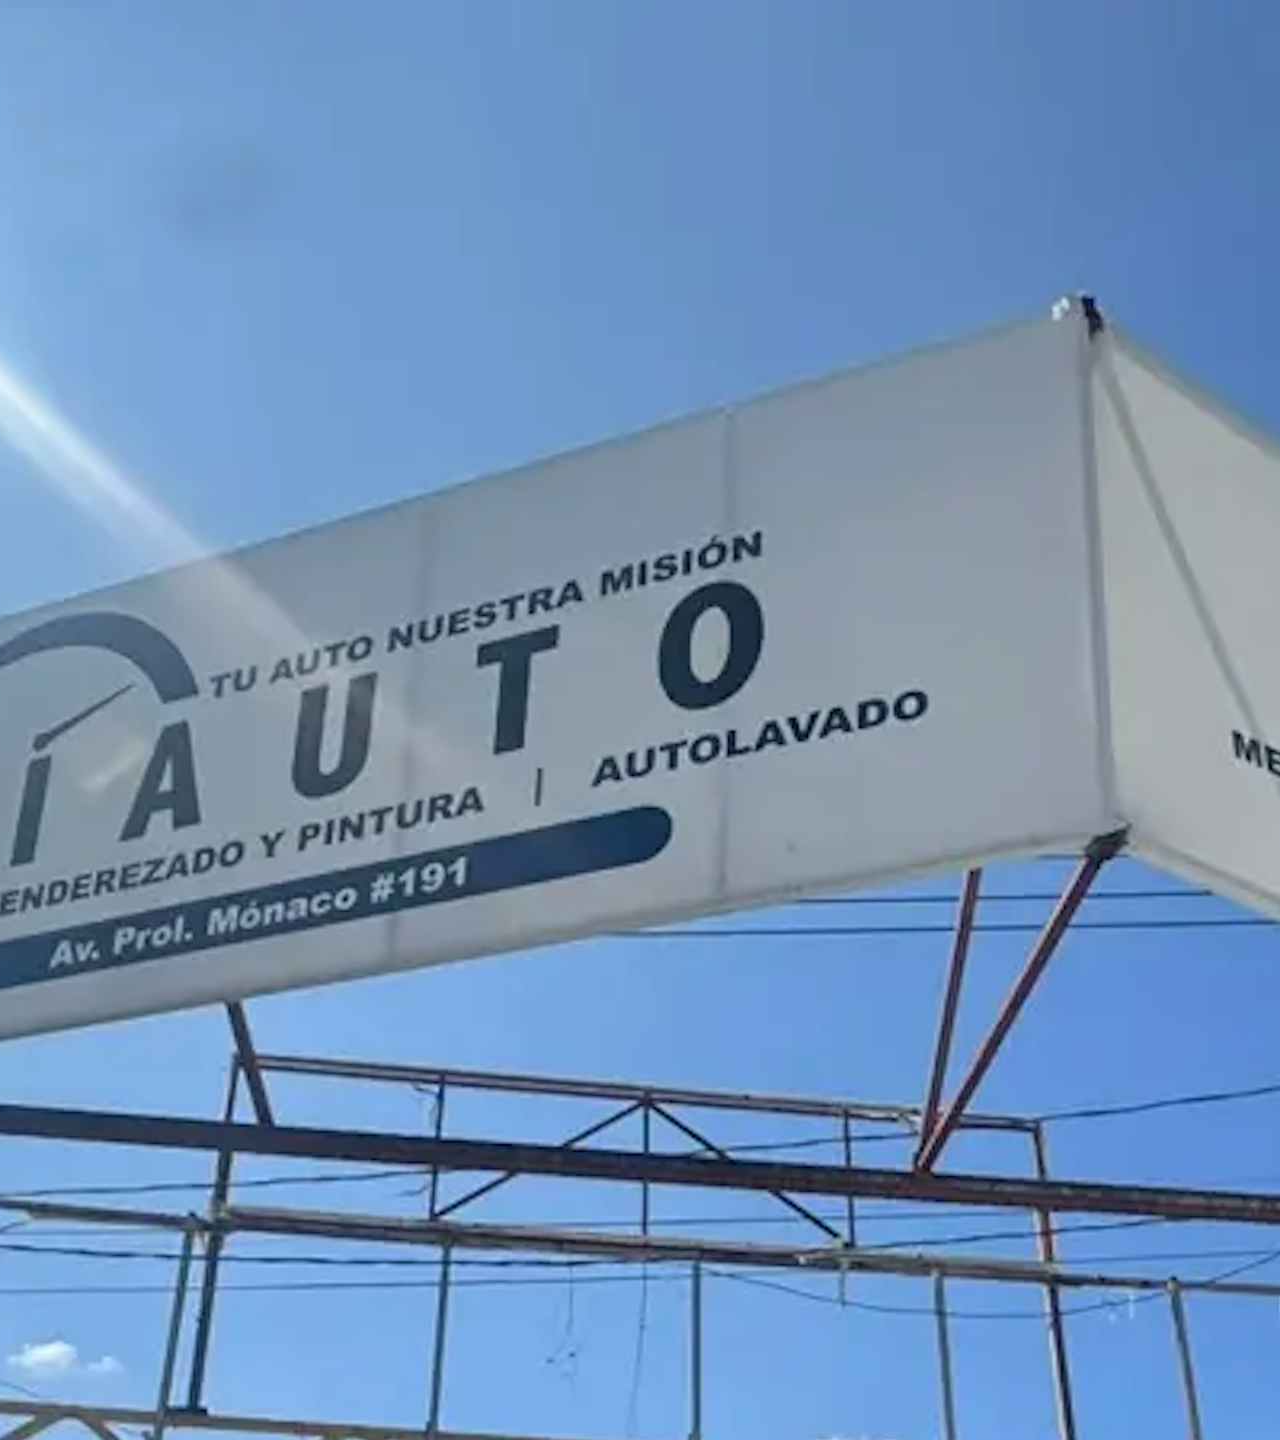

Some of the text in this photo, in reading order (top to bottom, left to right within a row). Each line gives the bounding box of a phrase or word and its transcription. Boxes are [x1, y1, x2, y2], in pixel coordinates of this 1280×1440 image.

[210, 532, 765, 699] TU AUTO NUESTRA MISIÓN
[260, 831, 286, 860] Y
[297, 786, 485, 852] PINTURA
[590, 689, 930, 788] AUTOLAVADO
[49, 856, 469, 971] Av. Prol. Mónaco #191
